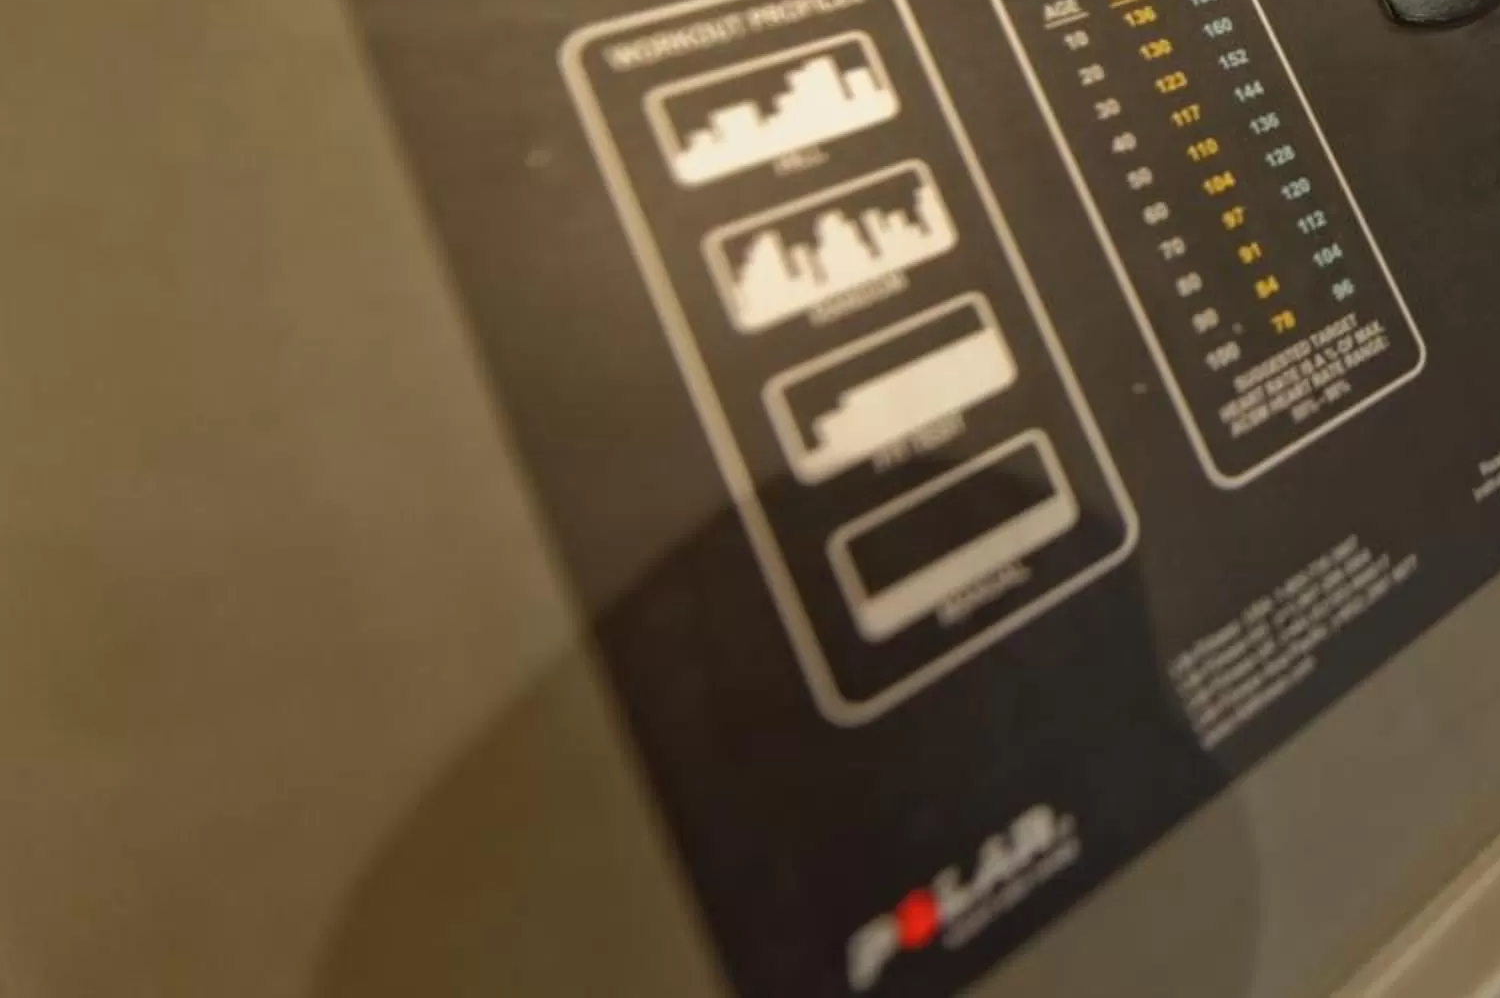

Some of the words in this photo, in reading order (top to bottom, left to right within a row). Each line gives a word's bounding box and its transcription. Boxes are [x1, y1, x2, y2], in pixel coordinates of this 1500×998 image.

[1203, 16, 1233, 38] 160
[1155, 71, 1188, 93] 123
[1218, 48, 1249, 70] 152
[1171, 104, 1201, 127] 117
[1234, 80, 1265, 102] 144
[1187, 137, 1219, 161] 110
[1250, 111, 1280, 134] 136
[1281, 177, 1311, 200] 120
[1297, 209, 1328, 234] 112
[1313, 242, 1343, 268] 104
